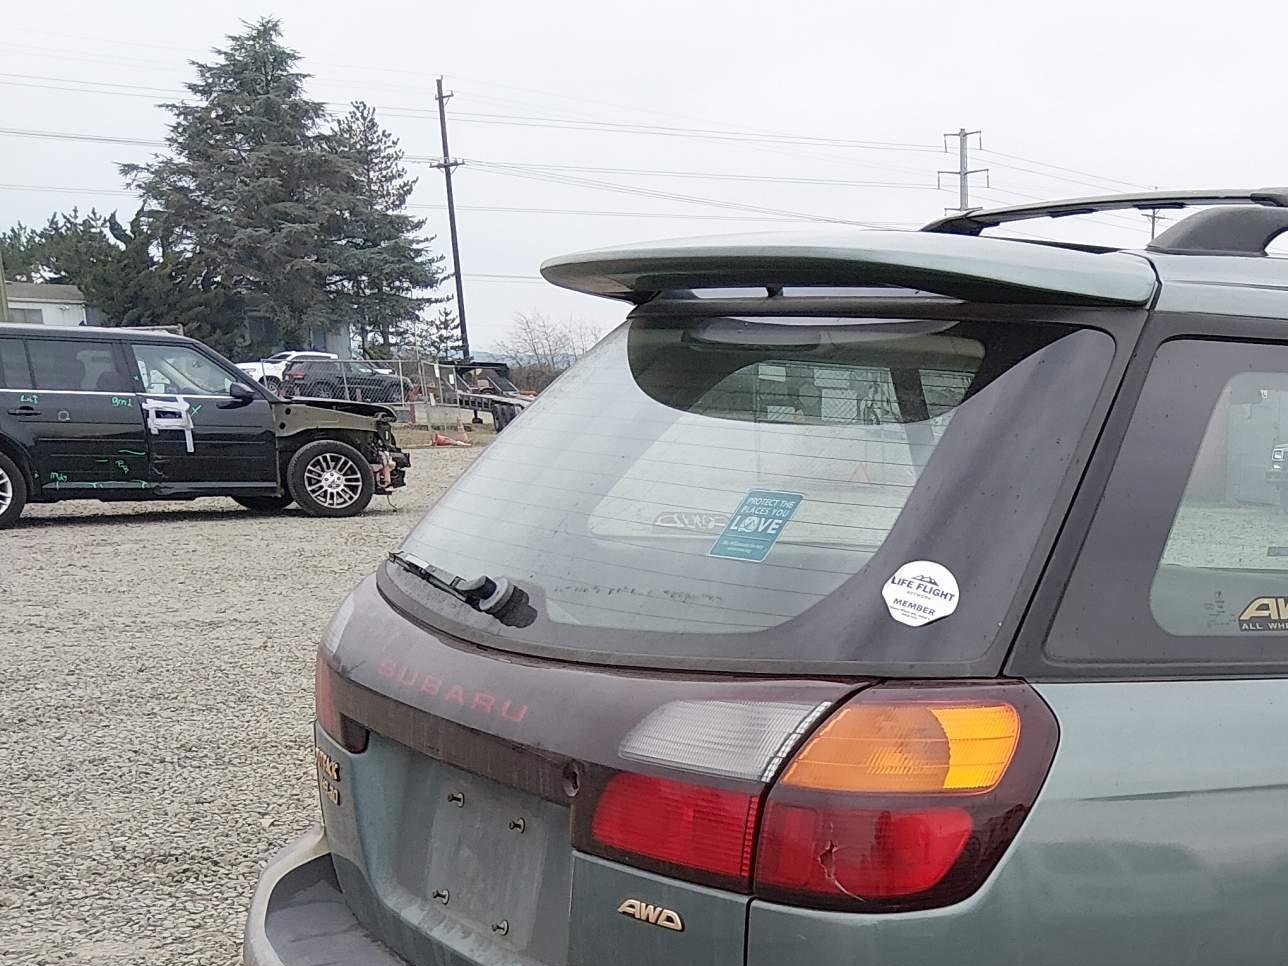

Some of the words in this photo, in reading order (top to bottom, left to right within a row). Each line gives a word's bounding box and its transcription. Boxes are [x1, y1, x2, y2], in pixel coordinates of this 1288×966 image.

[740, 505, 770, 515] PLACES
[771, 508, 791, 518] YOU
[746, 497, 779, 507] PROTECT
[780, 499, 796, 509] THE
[729, 515, 783, 534] LOVE
[890, 576, 914, 589] LIFE
[915, 582, 955, 602] FLIGHT
[893, 598, 936, 616] MEMBER
[1242, 622, 1263, 630] ALL
[377, 657, 529, 722] SUBARU
[617, 899, 683, 931] AWD
